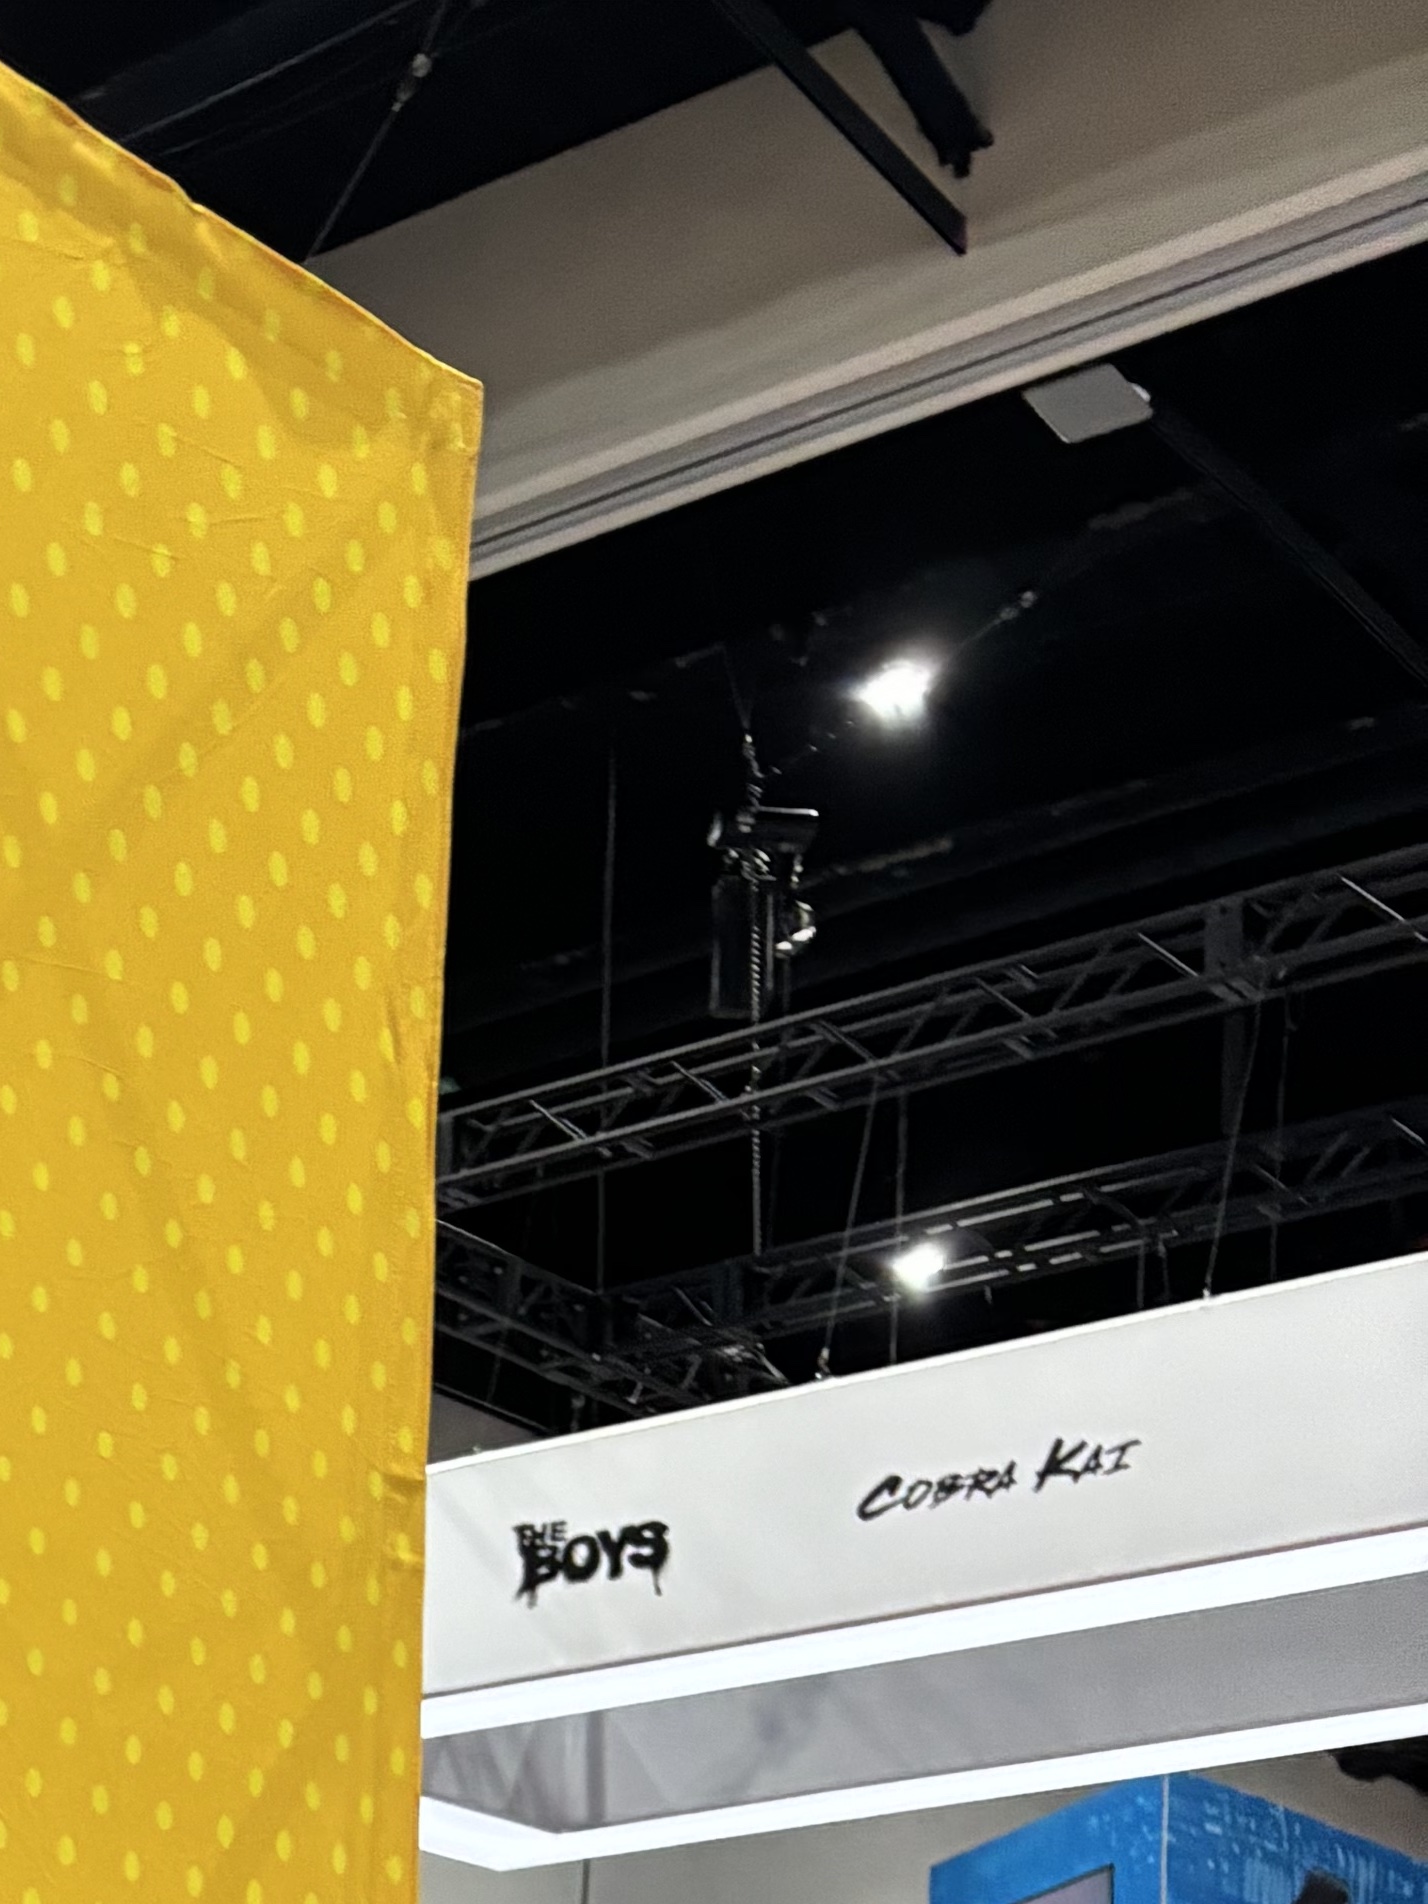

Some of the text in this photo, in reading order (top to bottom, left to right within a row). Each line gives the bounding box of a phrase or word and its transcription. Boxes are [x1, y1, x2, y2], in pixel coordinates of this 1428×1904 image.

[856, 1437, 1143, 1521] COBRA KAI
[515, 1521, 669, 1608] BOYS
